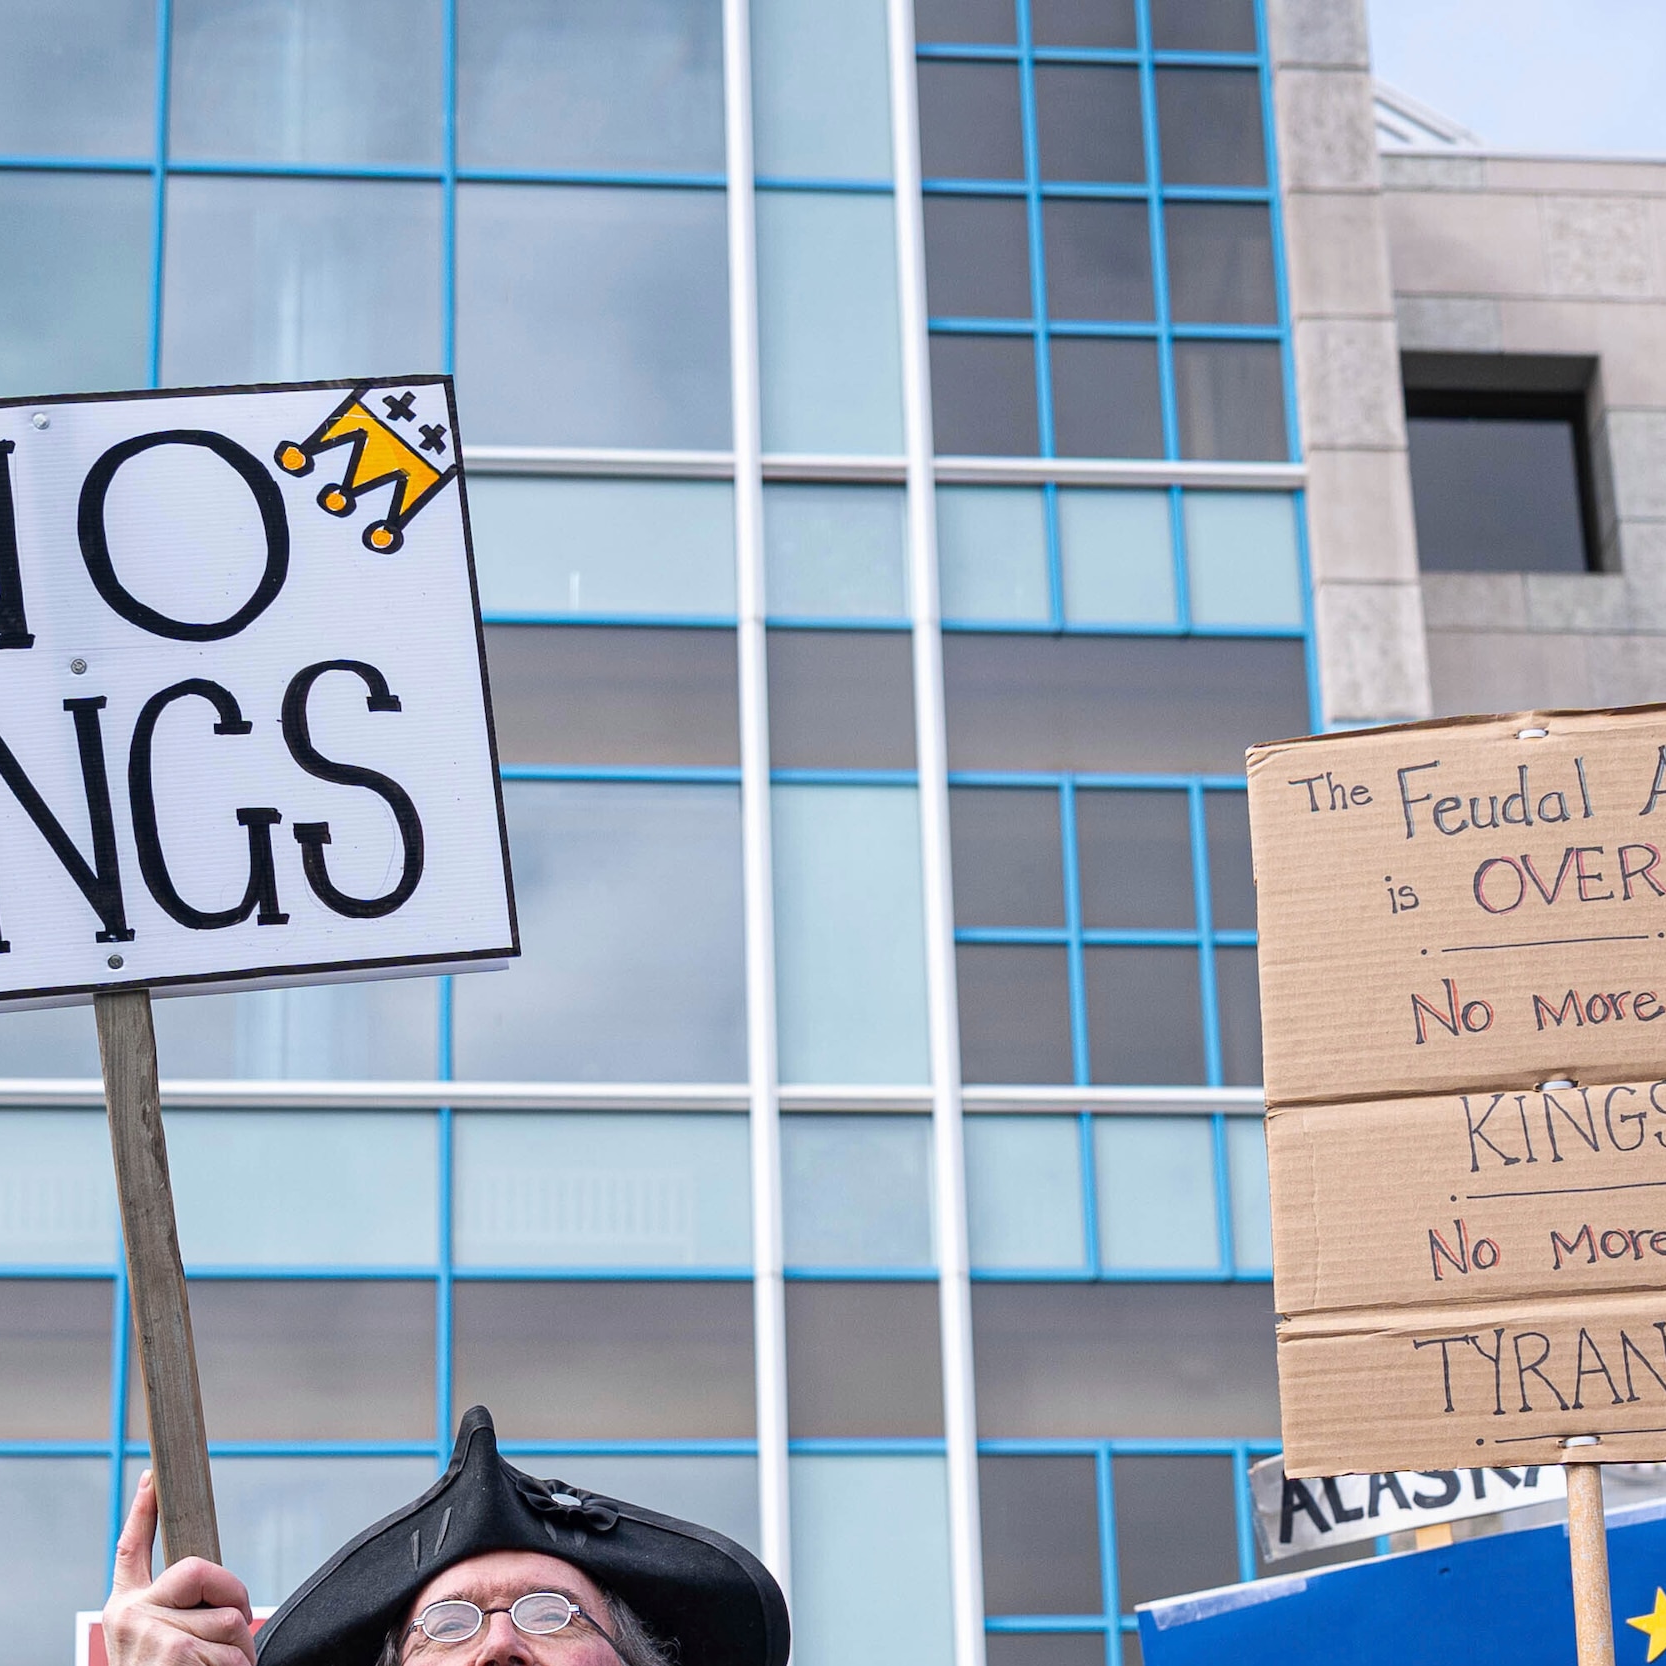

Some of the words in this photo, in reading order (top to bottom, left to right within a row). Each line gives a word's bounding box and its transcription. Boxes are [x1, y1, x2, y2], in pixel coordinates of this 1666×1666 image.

[1288, 771, 1373, 813] The
[1396, 755, 1595, 839] Feudal
[1386, 875, 1420, 915] is
[1411, 977, 1494, 1045] No
[1533, 985, 1666, 1032] More
[1427, 1218, 1501, 1282] No
